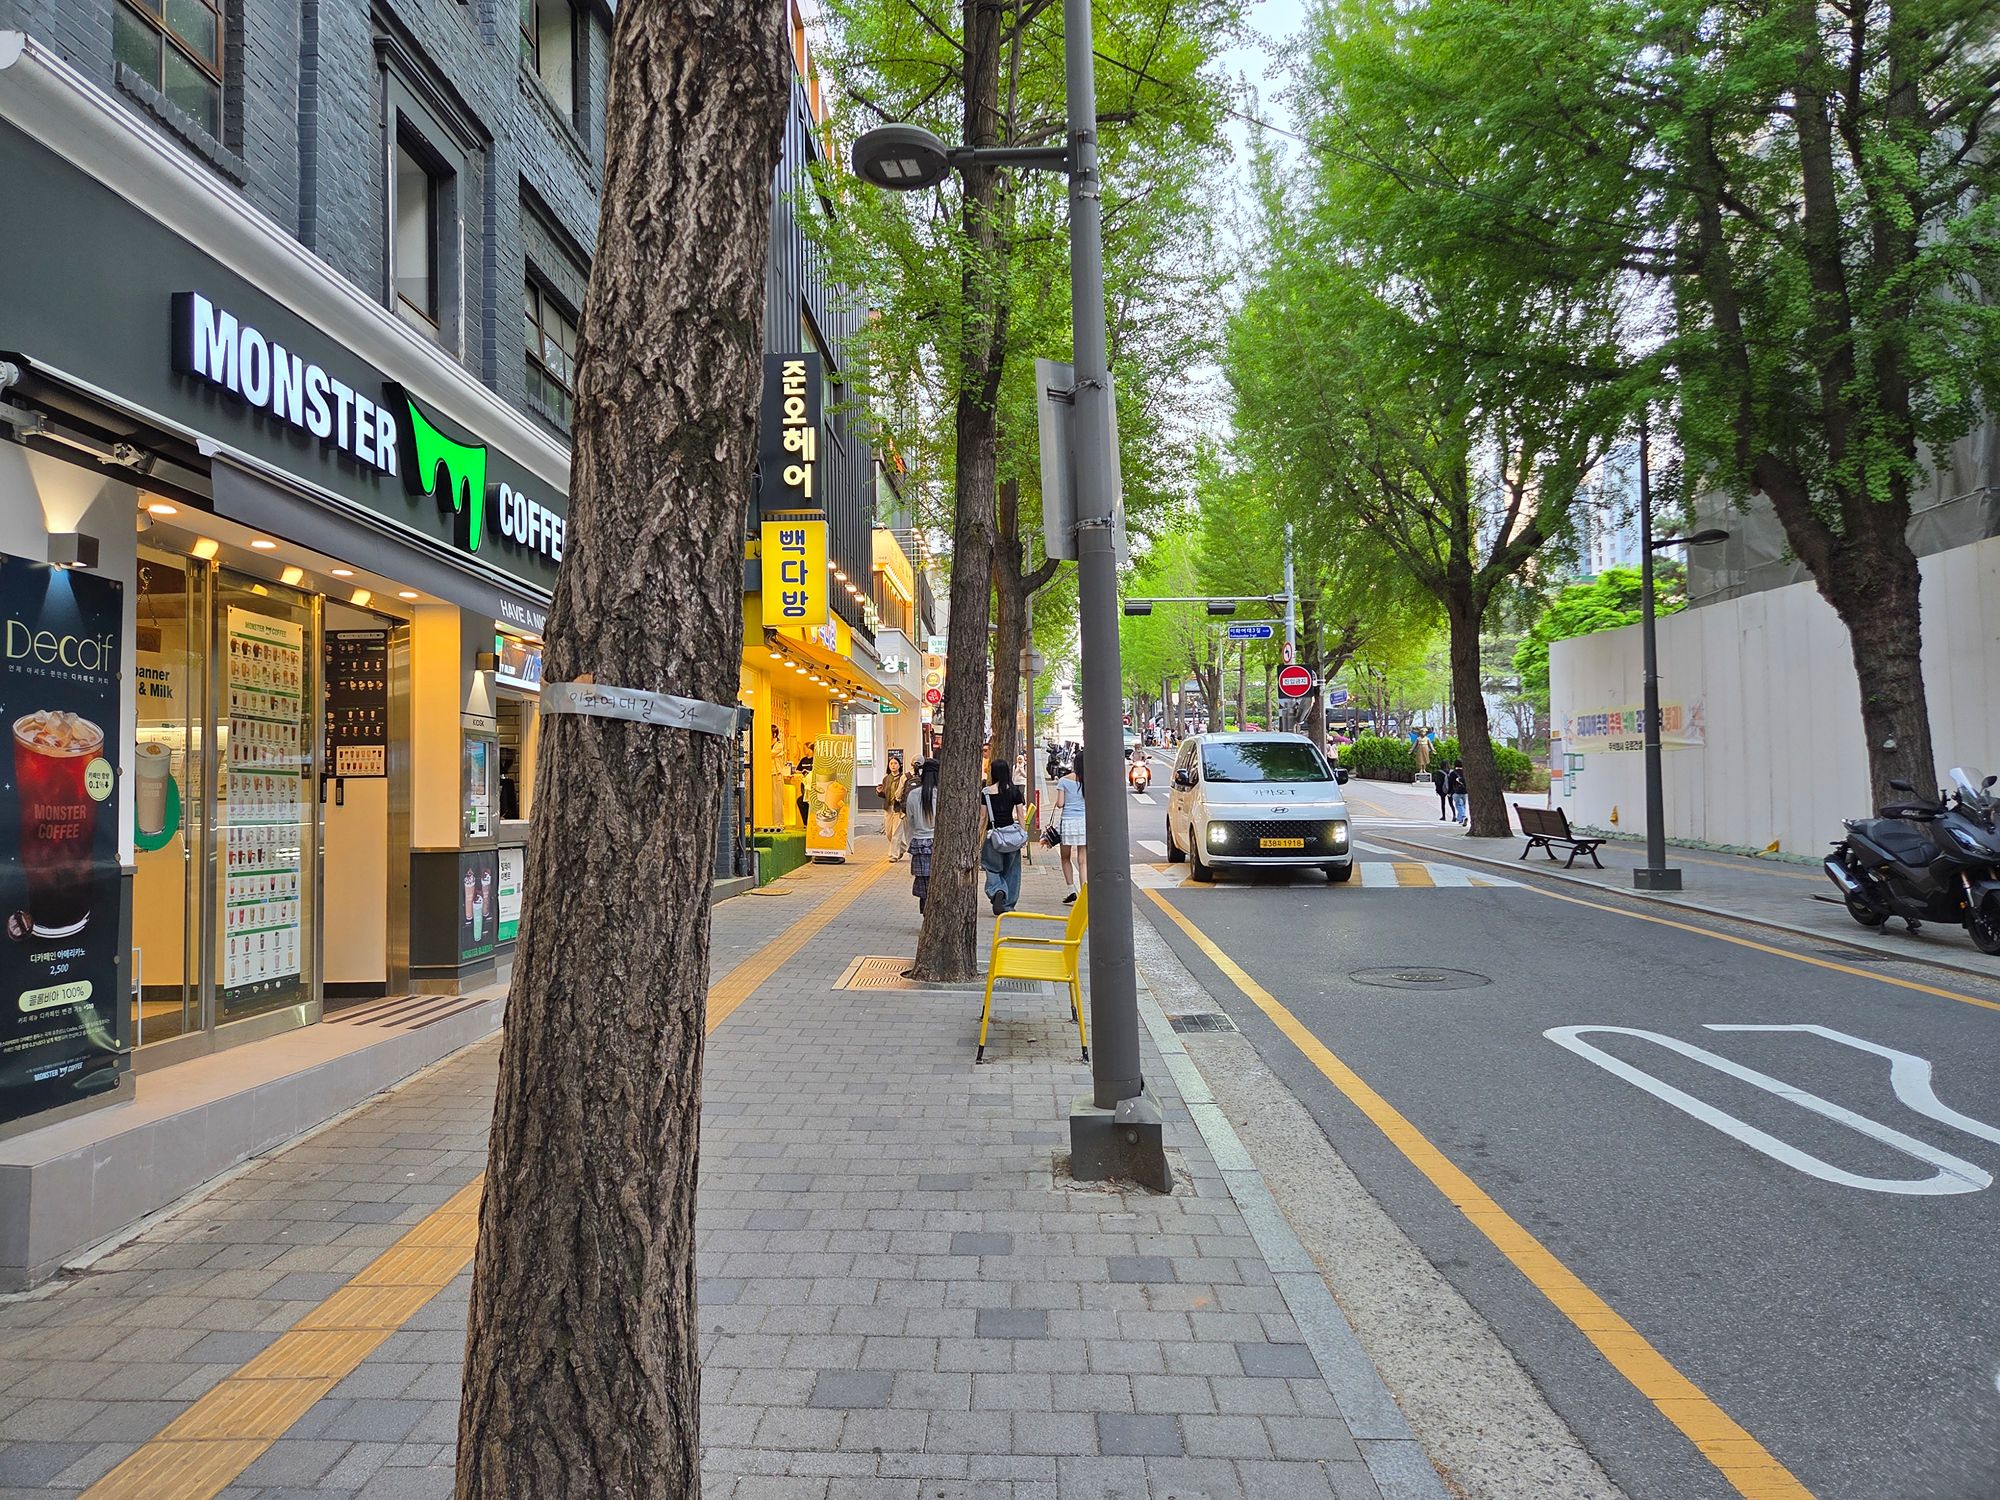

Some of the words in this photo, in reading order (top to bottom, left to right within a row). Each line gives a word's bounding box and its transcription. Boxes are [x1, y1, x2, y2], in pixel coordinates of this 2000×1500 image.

[193, 291, 397, 477] MONSTER
[499, 482, 567, 563] COFFE
[782, 360, 816, 498] 준오헤어
[779, 529, 809, 618] 빽다방
[500, 599, 526, 624] HAVE
[526, 609, 535, 627] A
[271, 627, 287, 638] COFFEE
[7, 620, 114, 671] Decaf
[138, 681, 147, 695] &
[150, 683, 173, 699] Milk
[569, 690, 655, 720] 이화여대길
[679, 703, 699, 721] 34
[472, 719, 485, 727] KIOSK
[814, 740, 854, 758] MATCHA
[33, 803, 87, 820] MONSTER
[38, 823, 80, 840] COFFEE
[30, 951, 57, 963] 디카페인
[57, 948, 86, 959] 아메리카노
[50, 963, 69, 976] 2,500
[29, 990, 60, 1007] 콜롬비아
[62, 986, 85, 999] 100%
[40, 1009, 60, 1019] 디카페인
[61, 1007, 73, 1016] 변경
[34, 1069, 59, 1082] MONSTER
